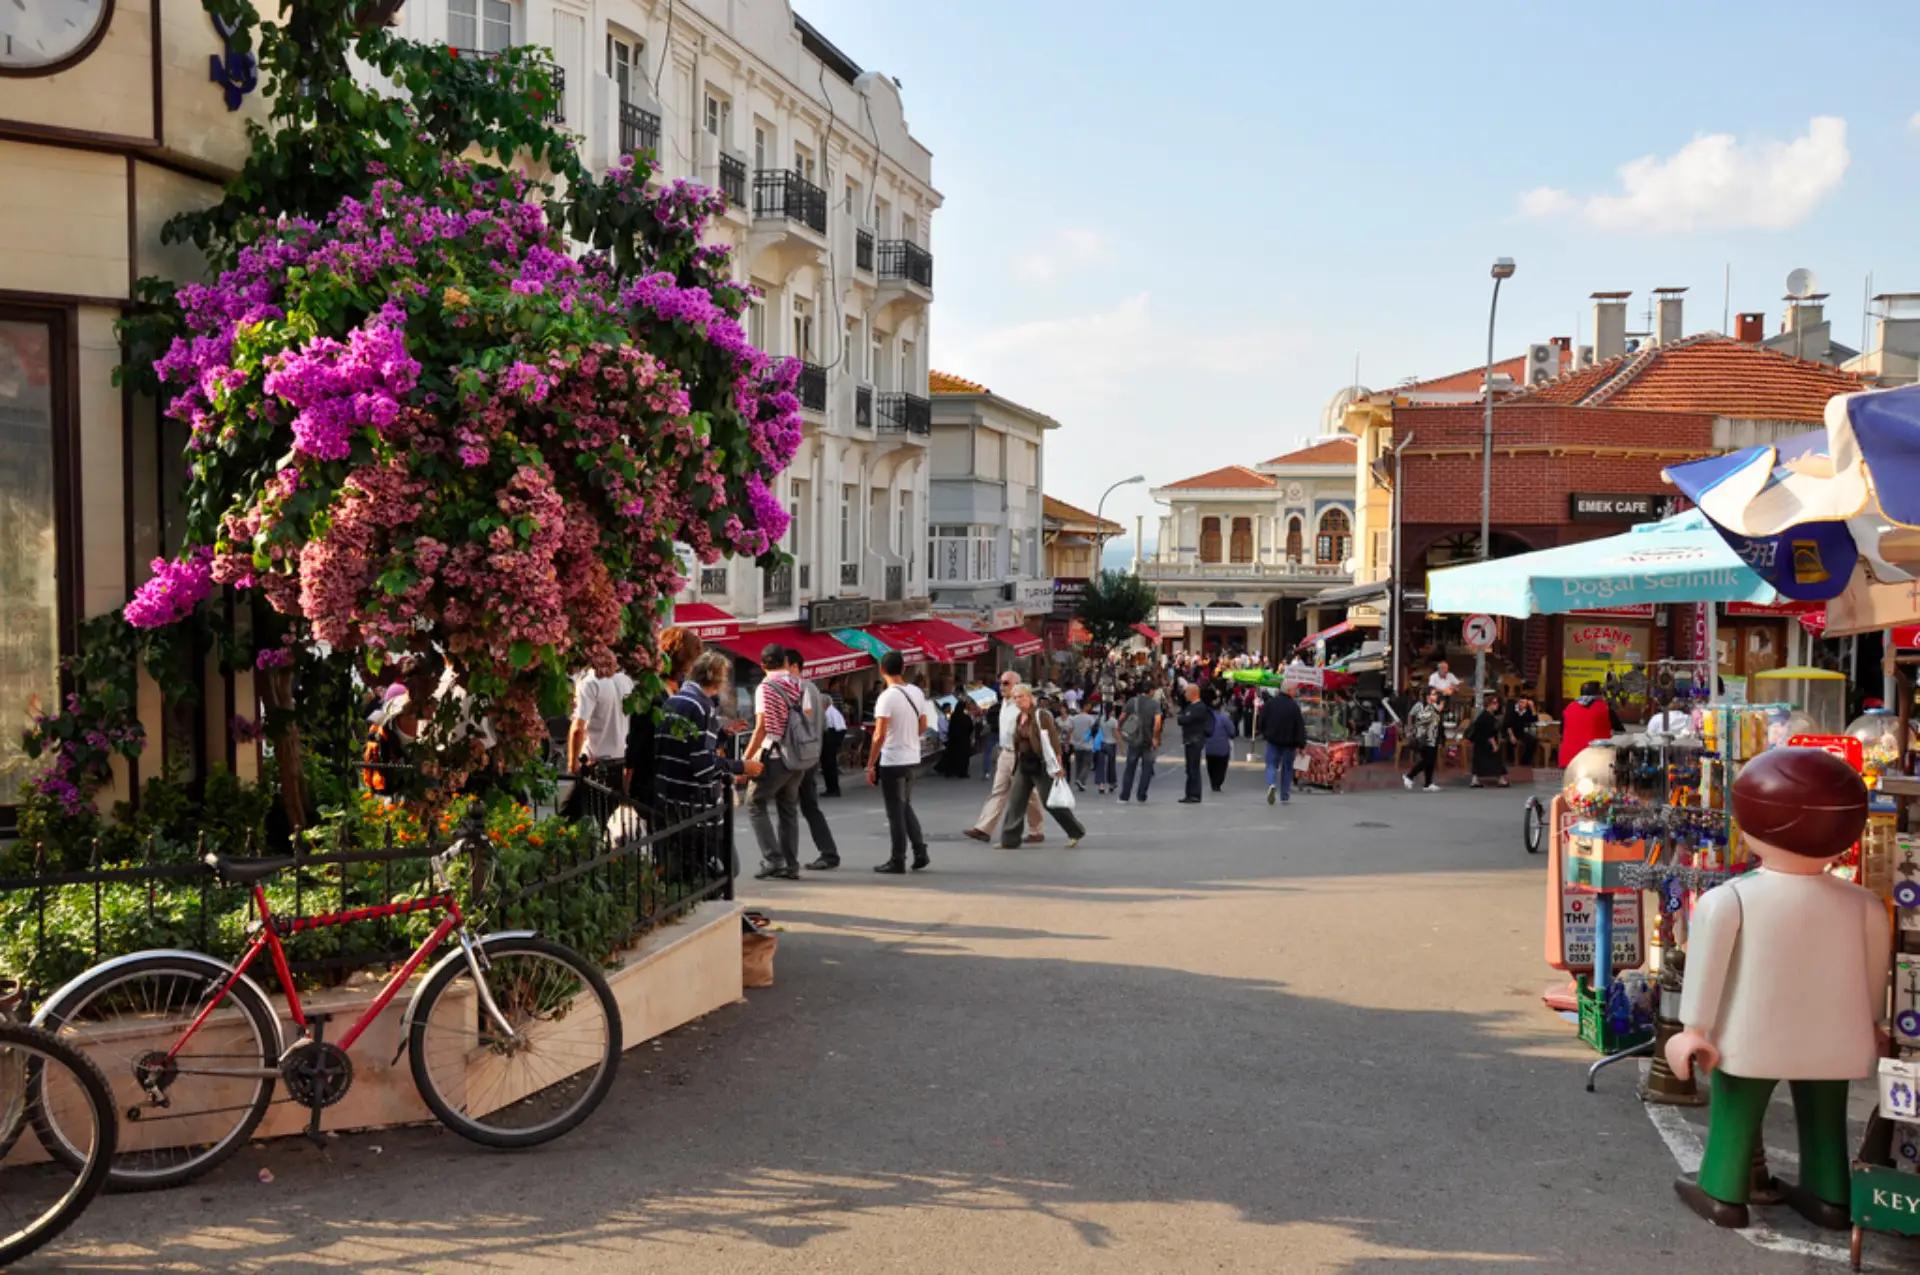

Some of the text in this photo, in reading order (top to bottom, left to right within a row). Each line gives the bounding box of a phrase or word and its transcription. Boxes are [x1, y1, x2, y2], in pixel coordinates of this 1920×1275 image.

[1577, 500, 1648, 513] EMEK CAFE
[1563, 569, 1739, 598] Doğal Serinlik
[1572, 625, 1633, 648] ECZANE
[1564, 913, 1590, 924] THY
[1872, 1187, 1920, 1215] KEY
